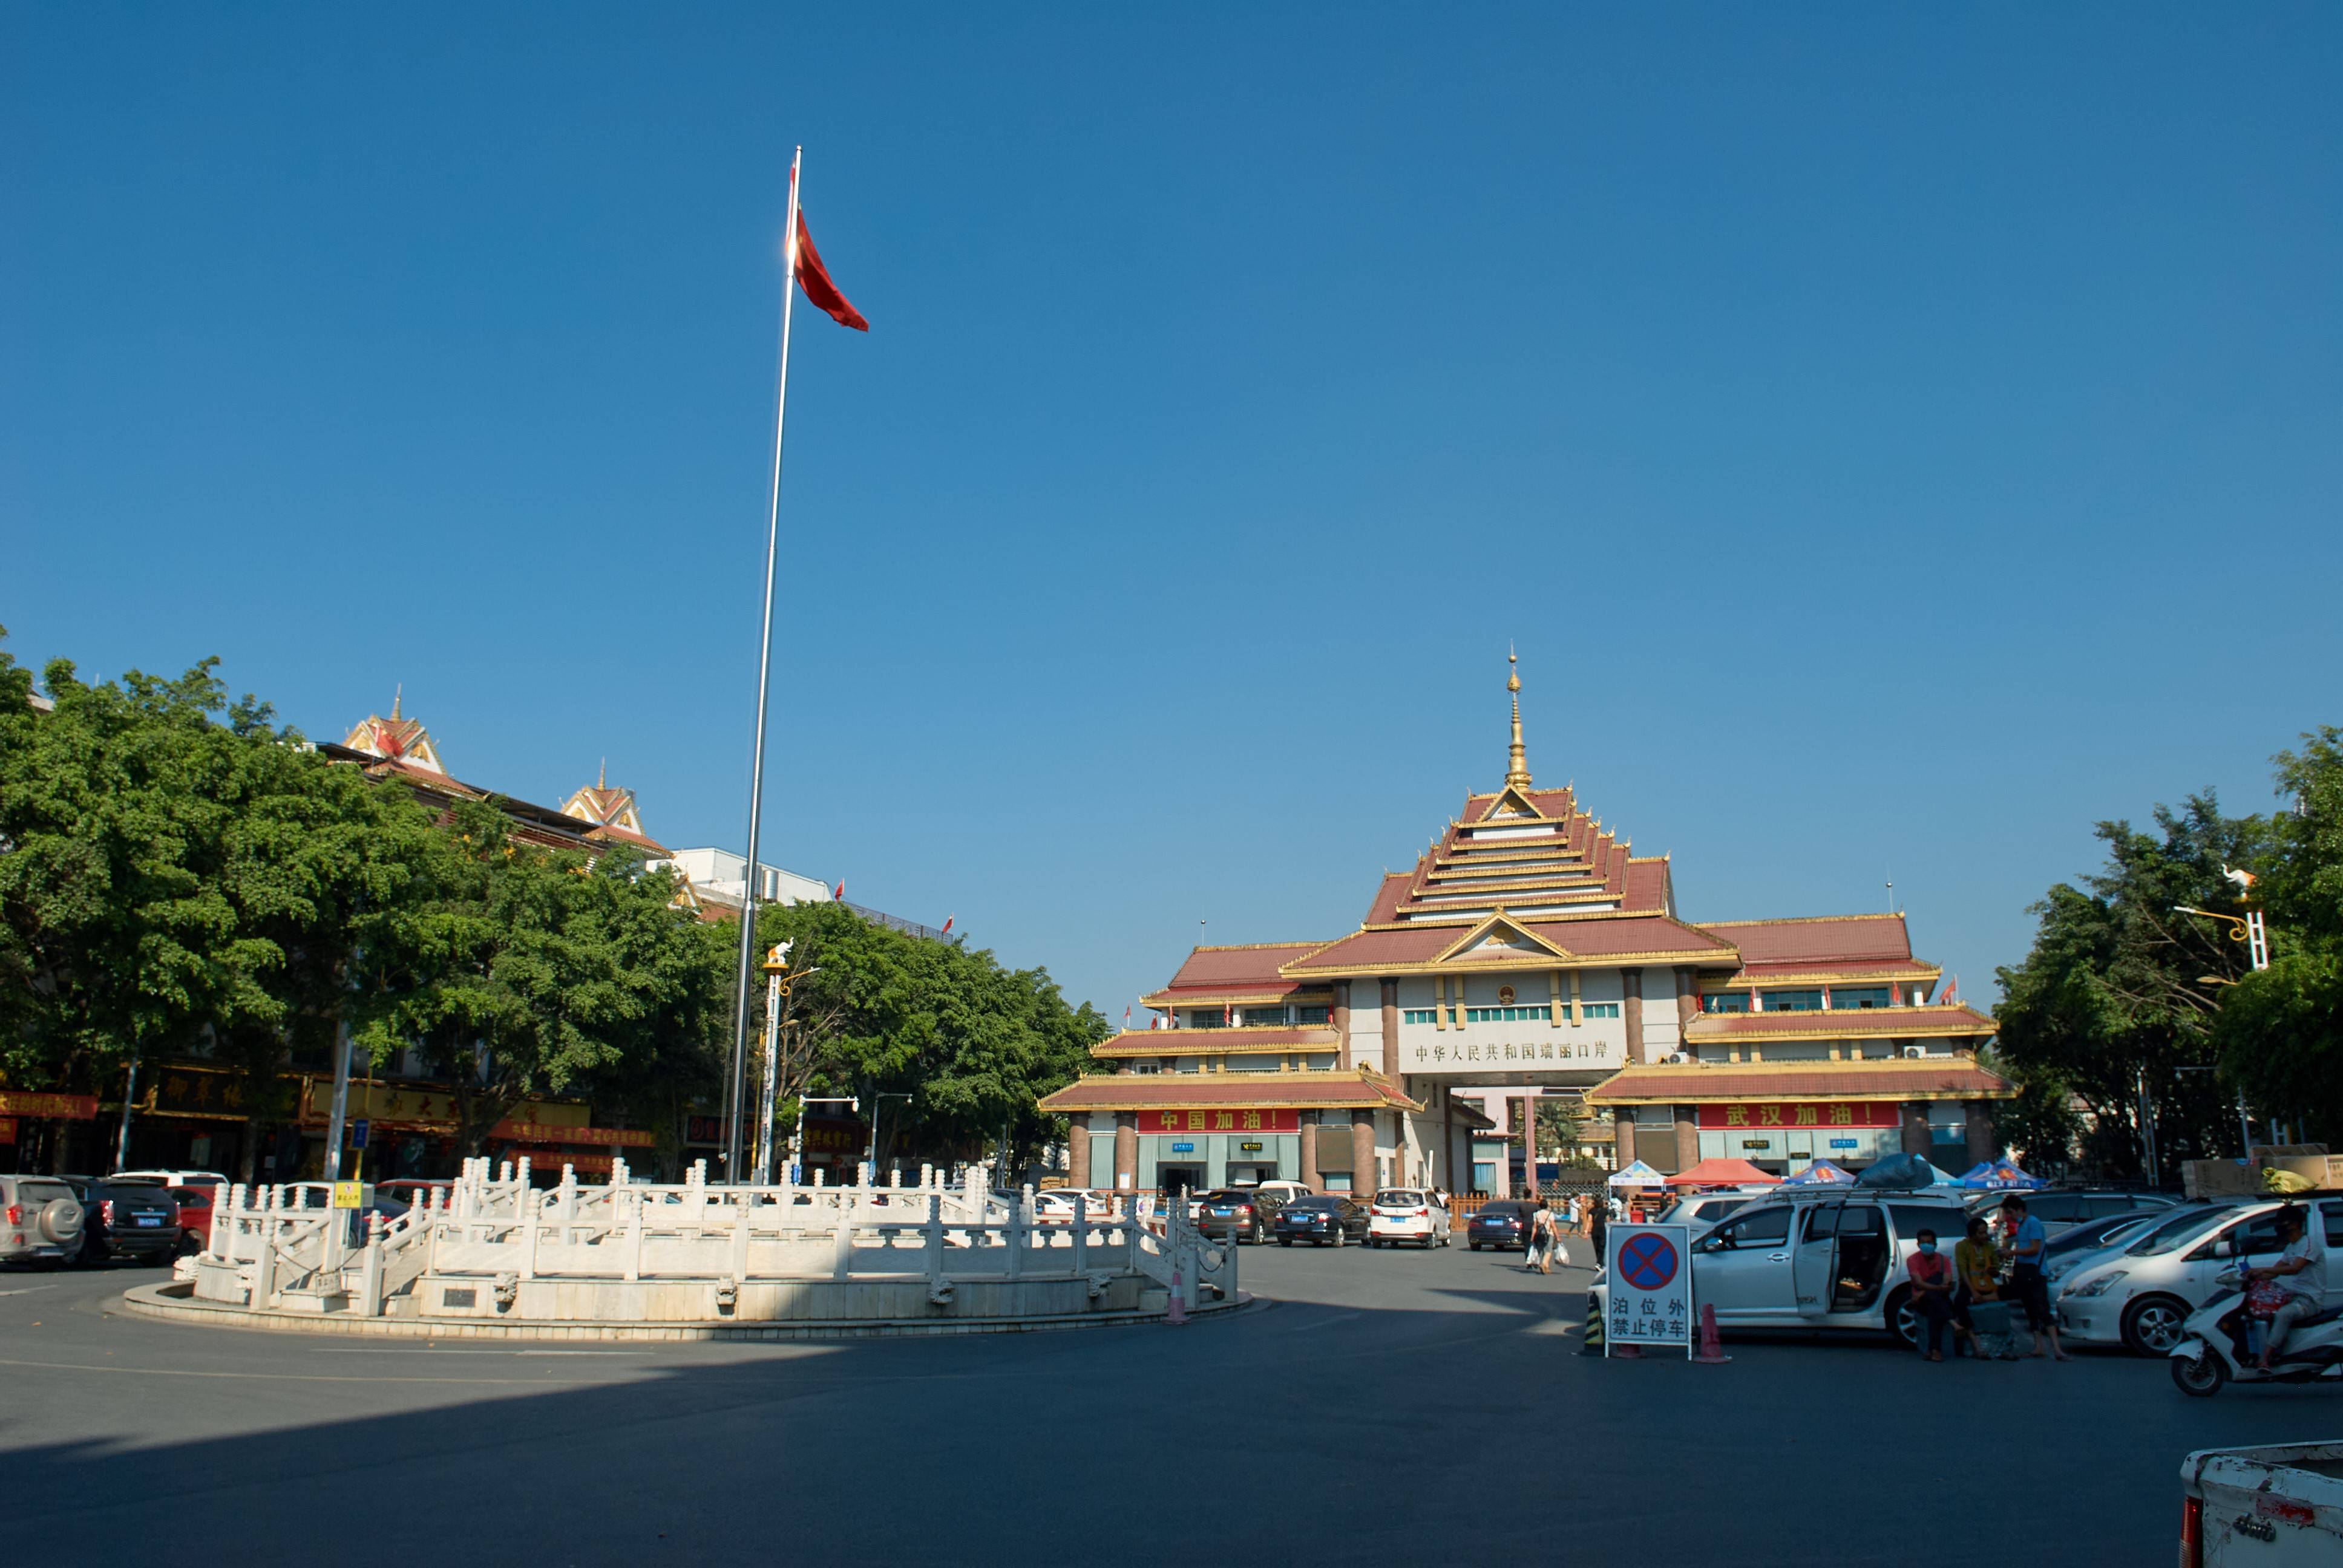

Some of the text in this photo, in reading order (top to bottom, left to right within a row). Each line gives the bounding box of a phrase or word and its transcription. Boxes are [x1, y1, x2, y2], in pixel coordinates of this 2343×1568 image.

[1416, 1040, 1609, 1062] 中华人民共和国瑞丽口岸
[1161, 1110, 1276, 1130] 中国加油！
[1726, 1103, 1871, 1126] 武汉加油！
[1613, 1297, 1685, 1316] 泊位外
[1613, 1318, 1685, 1338] 禁止停车
